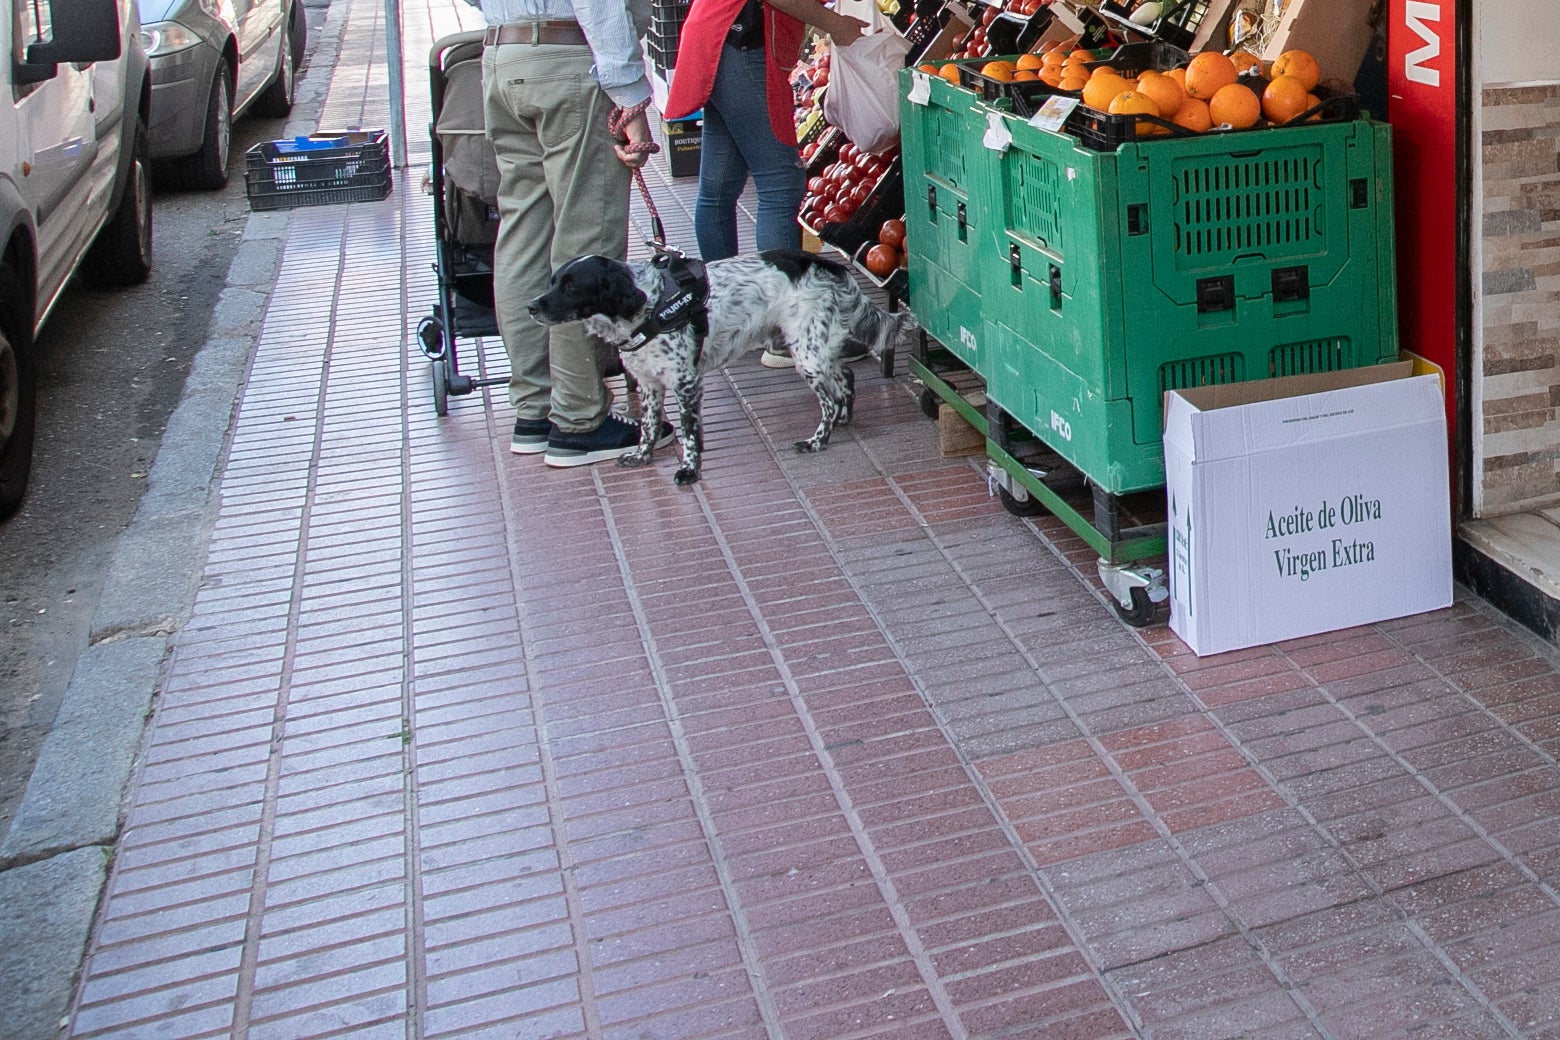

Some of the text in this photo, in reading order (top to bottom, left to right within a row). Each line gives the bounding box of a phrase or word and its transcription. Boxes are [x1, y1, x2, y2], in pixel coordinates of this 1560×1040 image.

[960, 324, 977, 351] IFCO
[1050, 409, 1072, 442] IFCO
[1265, 493, 1382, 540] Aceite de Oliva
[1274, 537, 1376, 582] Virgen Extra
